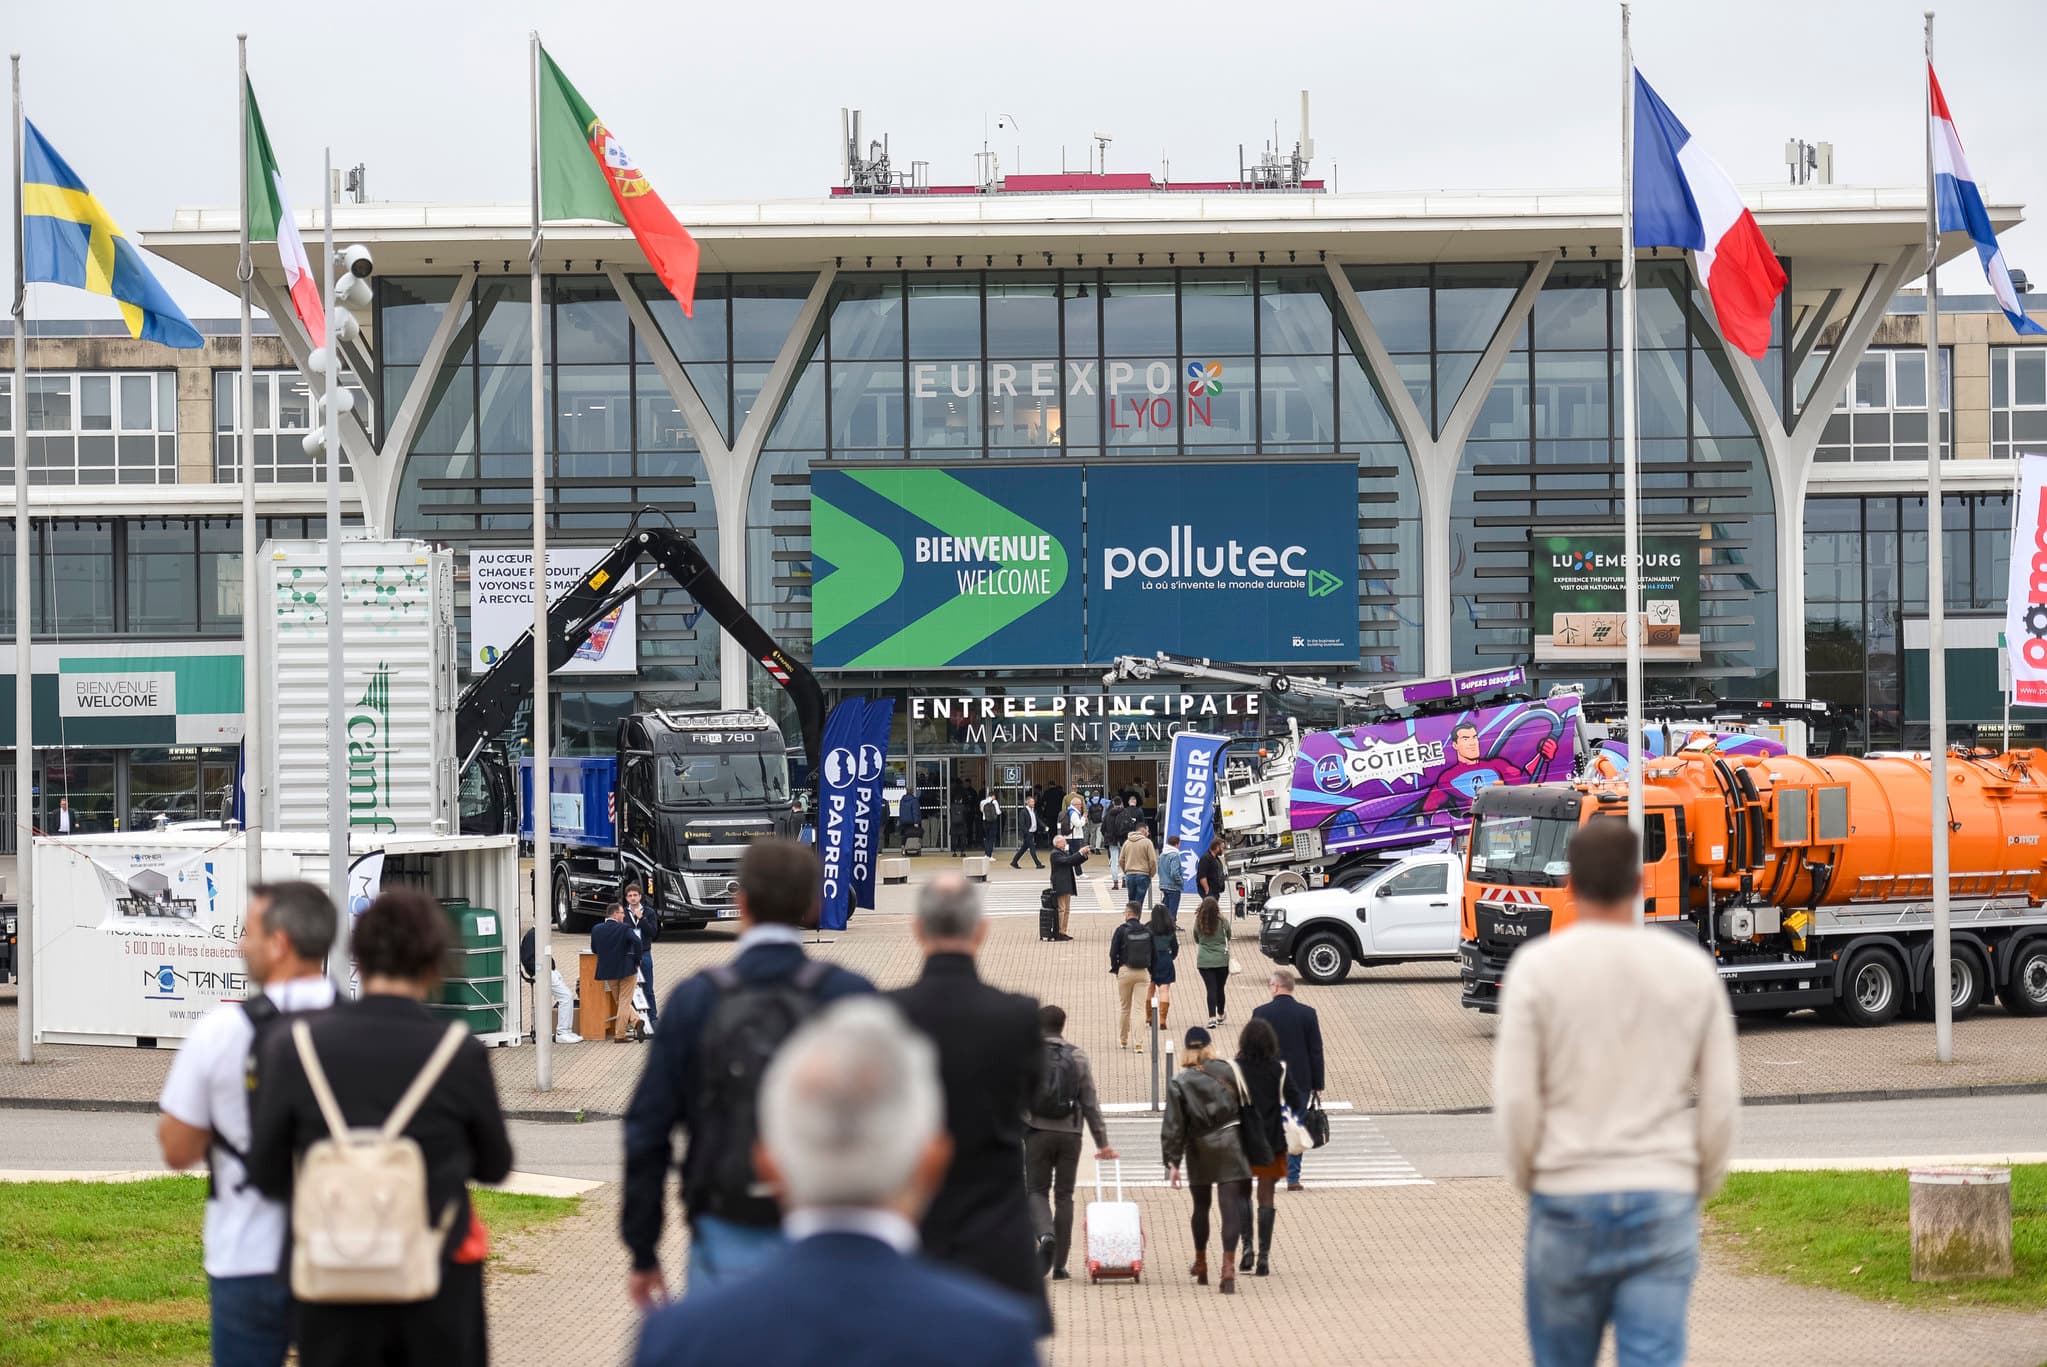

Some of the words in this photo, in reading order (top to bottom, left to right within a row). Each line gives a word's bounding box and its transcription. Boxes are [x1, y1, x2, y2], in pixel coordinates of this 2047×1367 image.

[914, 361, 1172, 399] EUREXPO
[1111, 397, 1212, 430] LYON
[478, 555, 494, 563] AU
[497, 554, 532, 563] CŒUR
[915, 534, 1051, 563] BIENVENUE
[1104, 525, 1308, 590] pollutec
[479, 568, 531, 577] CHAQUE
[957, 568, 1051, 596] WELCOME
[479, 581, 526, 590] VOYONS
[1141, 580, 1153, 590] Là
[1155, 580, 1168, 590] où
[1217, 580, 1227, 589] le
[1228, 580, 1264, 589] monde
[1266, 579, 1306, 589] durable
[478, 593, 487, 603] À
[76, 680, 158, 694] BIENVENUE
[77, 694, 158, 707] WELCOME
[912, 697, 1038, 719] ENTREE
[1052, 693, 1260, 716] PRINCIPALE
[724, 733, 755, 742] 780
[966, 723, 1039, 743] MAIN
[1351, 741, 1443, 773] CÔTIÈRE
[1179, 748, 1211, 842] KAISER
[853, 787, 873, 881] PAPREC
[823, 794, 846, 899] PAPREC
[1493, 922, 1527, 937] MAN
